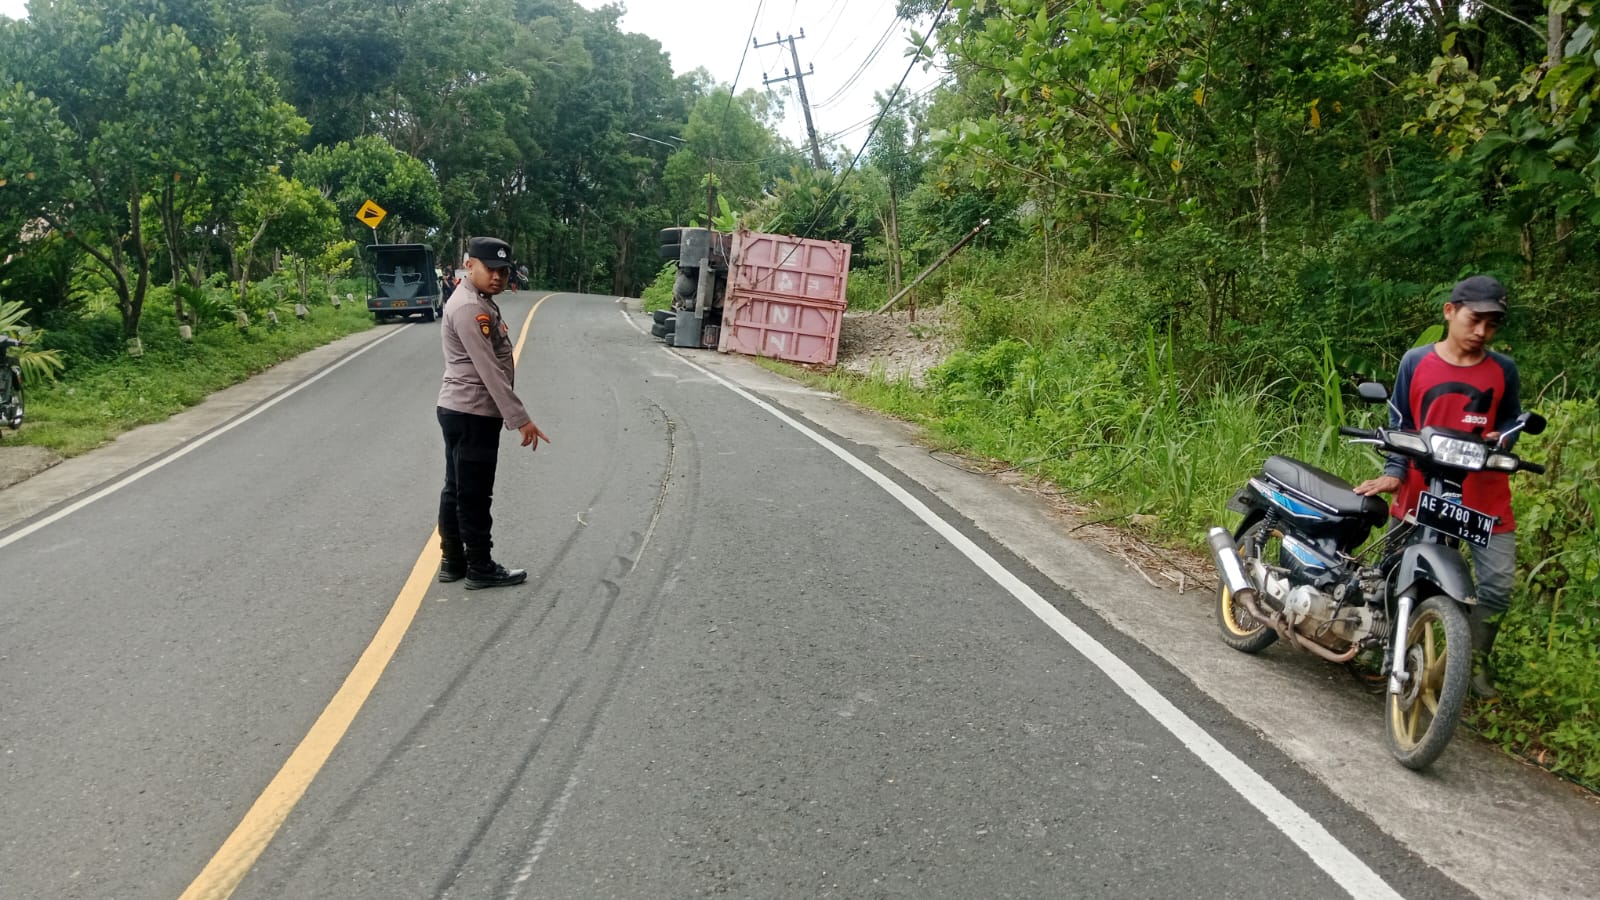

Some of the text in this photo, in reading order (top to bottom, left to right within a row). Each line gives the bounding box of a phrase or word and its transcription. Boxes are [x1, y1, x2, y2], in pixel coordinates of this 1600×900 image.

[1421, 495, 1437, 512] AE
[1441, 502, 1470, 523] 2780
[1477, 515, 1491, 533] YN
